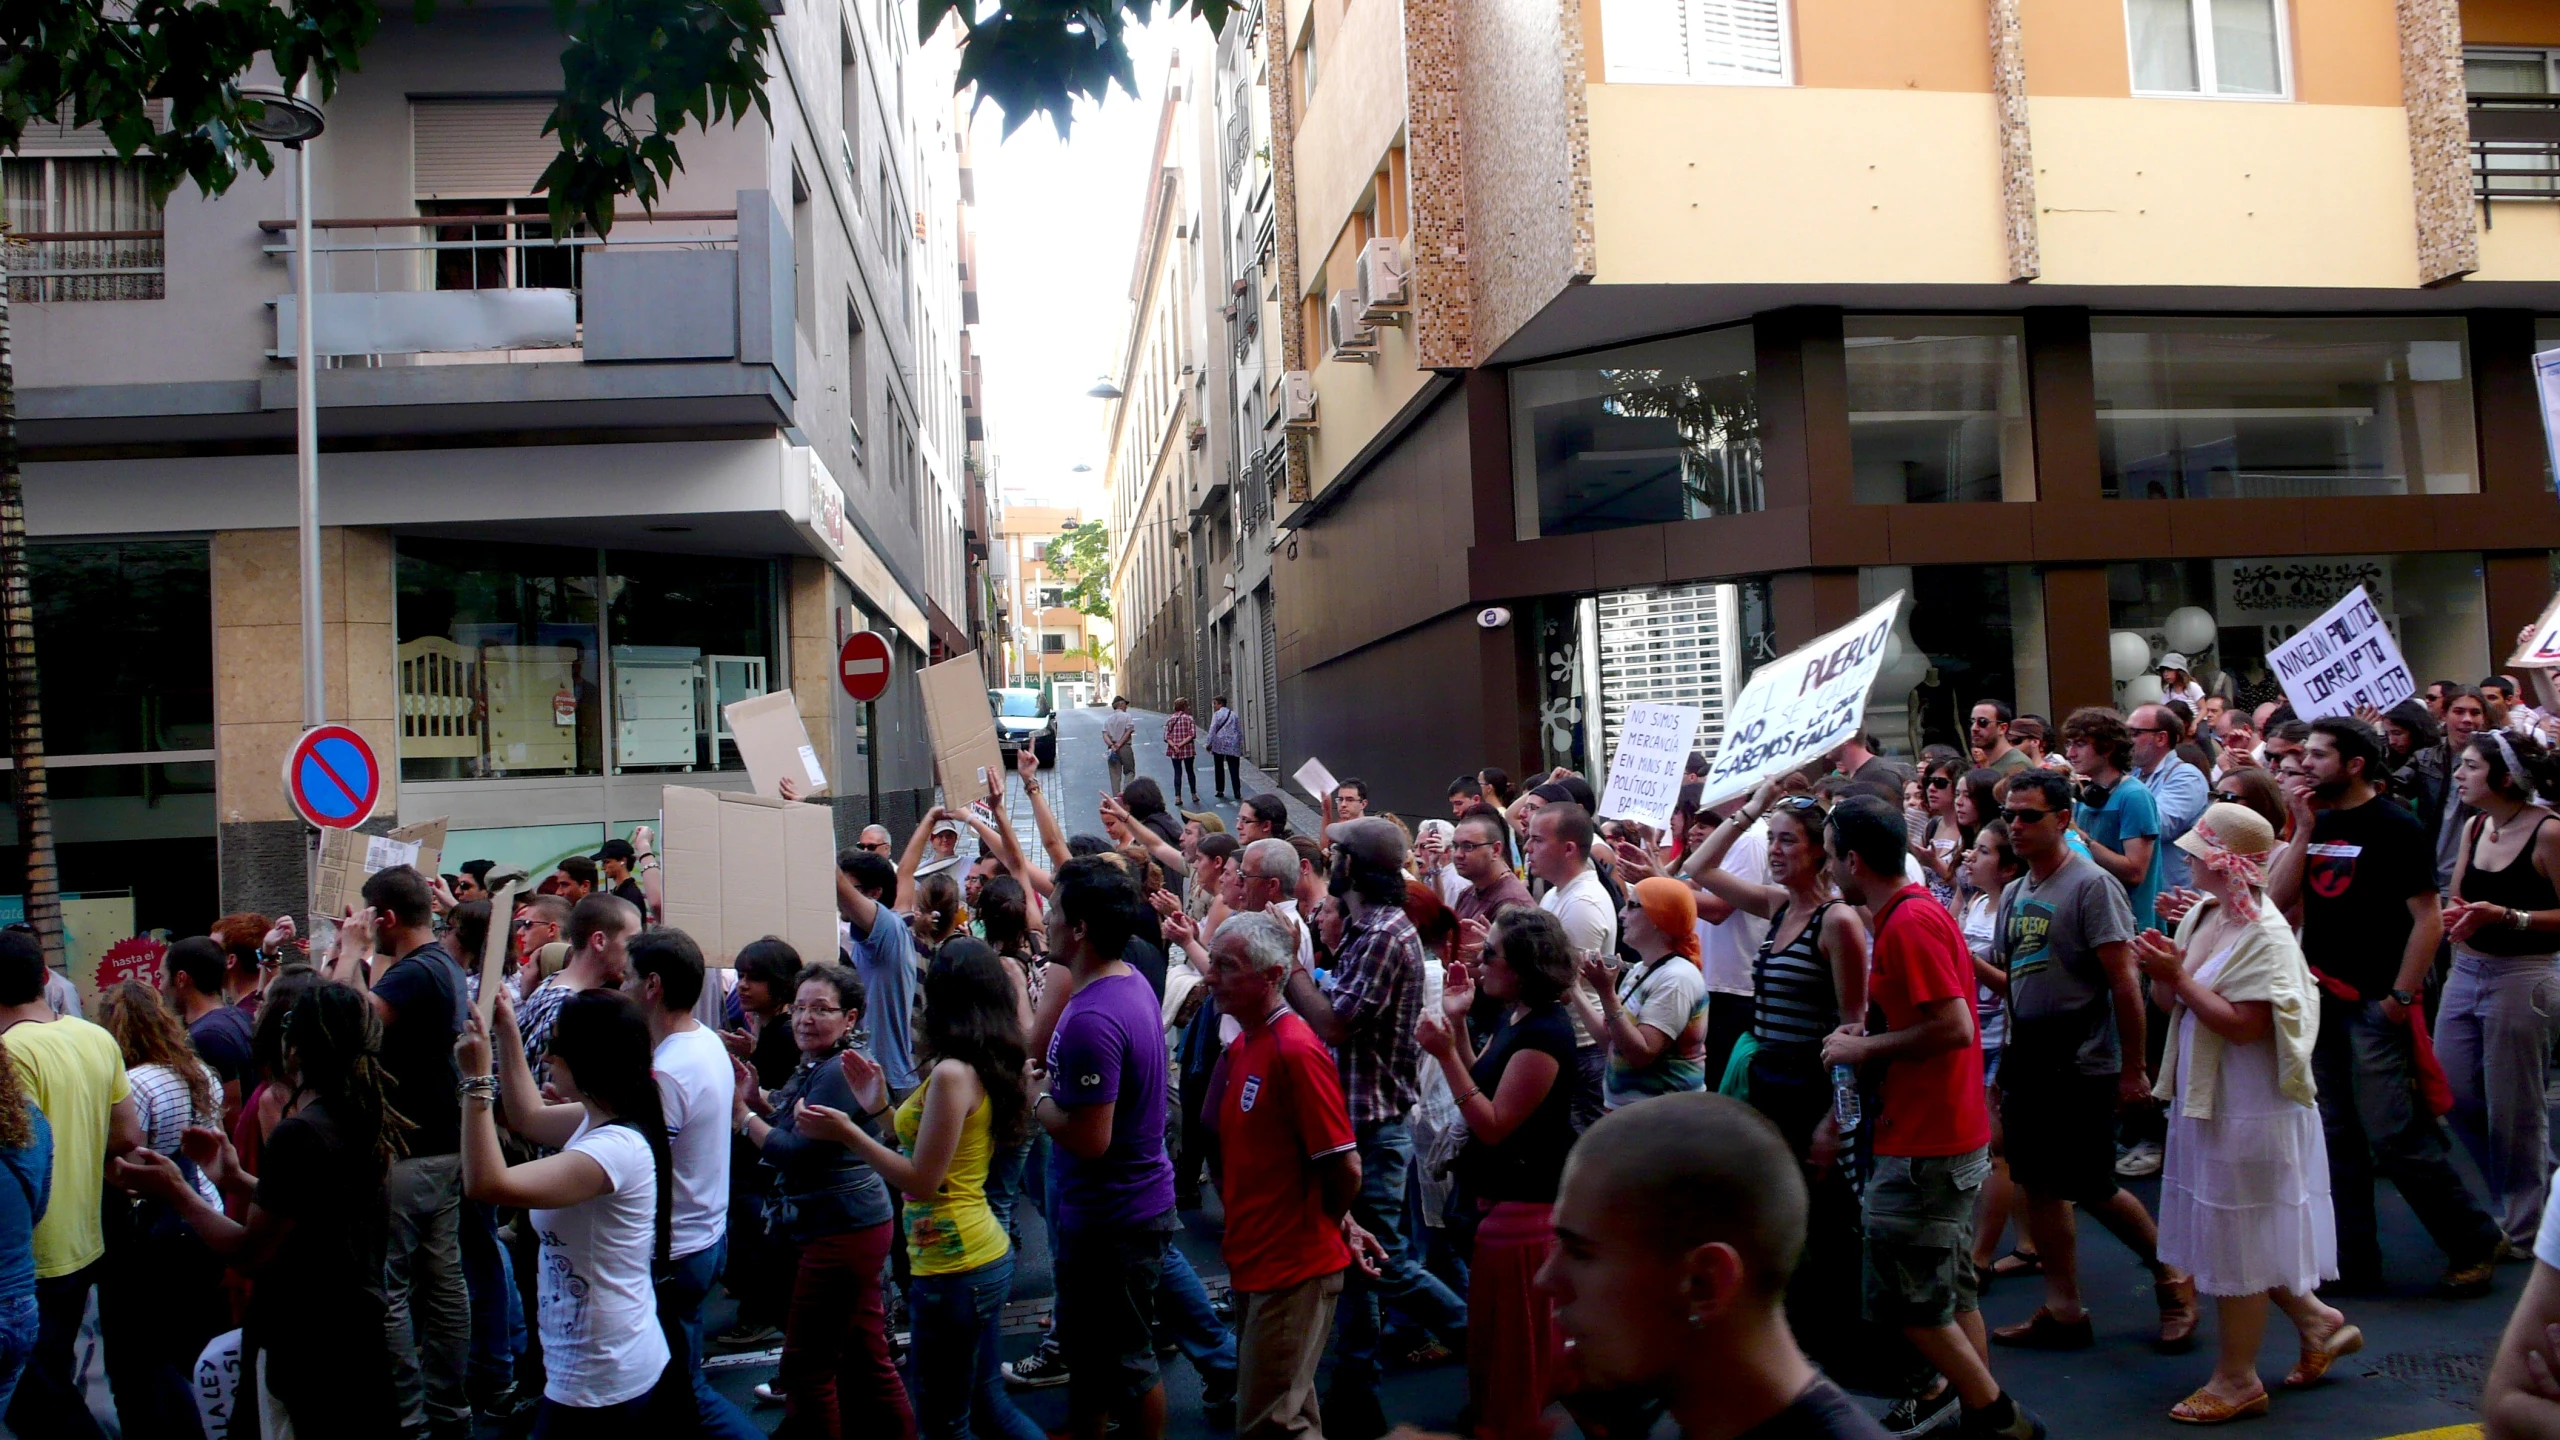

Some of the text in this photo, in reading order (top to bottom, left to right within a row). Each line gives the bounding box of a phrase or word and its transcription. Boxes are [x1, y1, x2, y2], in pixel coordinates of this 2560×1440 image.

[1739, 618, 1888, 724] EL PUEBLO
[2276, 632, 2332, 680] NINGÚN
[2304, 636, 2387, 704] CORRUPTO
[1806, 685, 1865, 730] LO QUE
[2366, 665, 2413, 710] LISTA
[1631, 710, 1680, 730] NO SOMOS
[1728, 717, 1766, 751] NO
[1776, 699, 1805, 729] SE
[1619, 753, 1677, 777] EN MANOS DE
[1627, 733, 1679, 753] MERCANCÍA
[1712, 708, 1853, 785] SABEMOS FALLA
[1613, 774, 1668, 798] POLÍTICOS Y
[112, 950, 155, 967] hasta el
[199, 1360, 220, 1398] LEY
